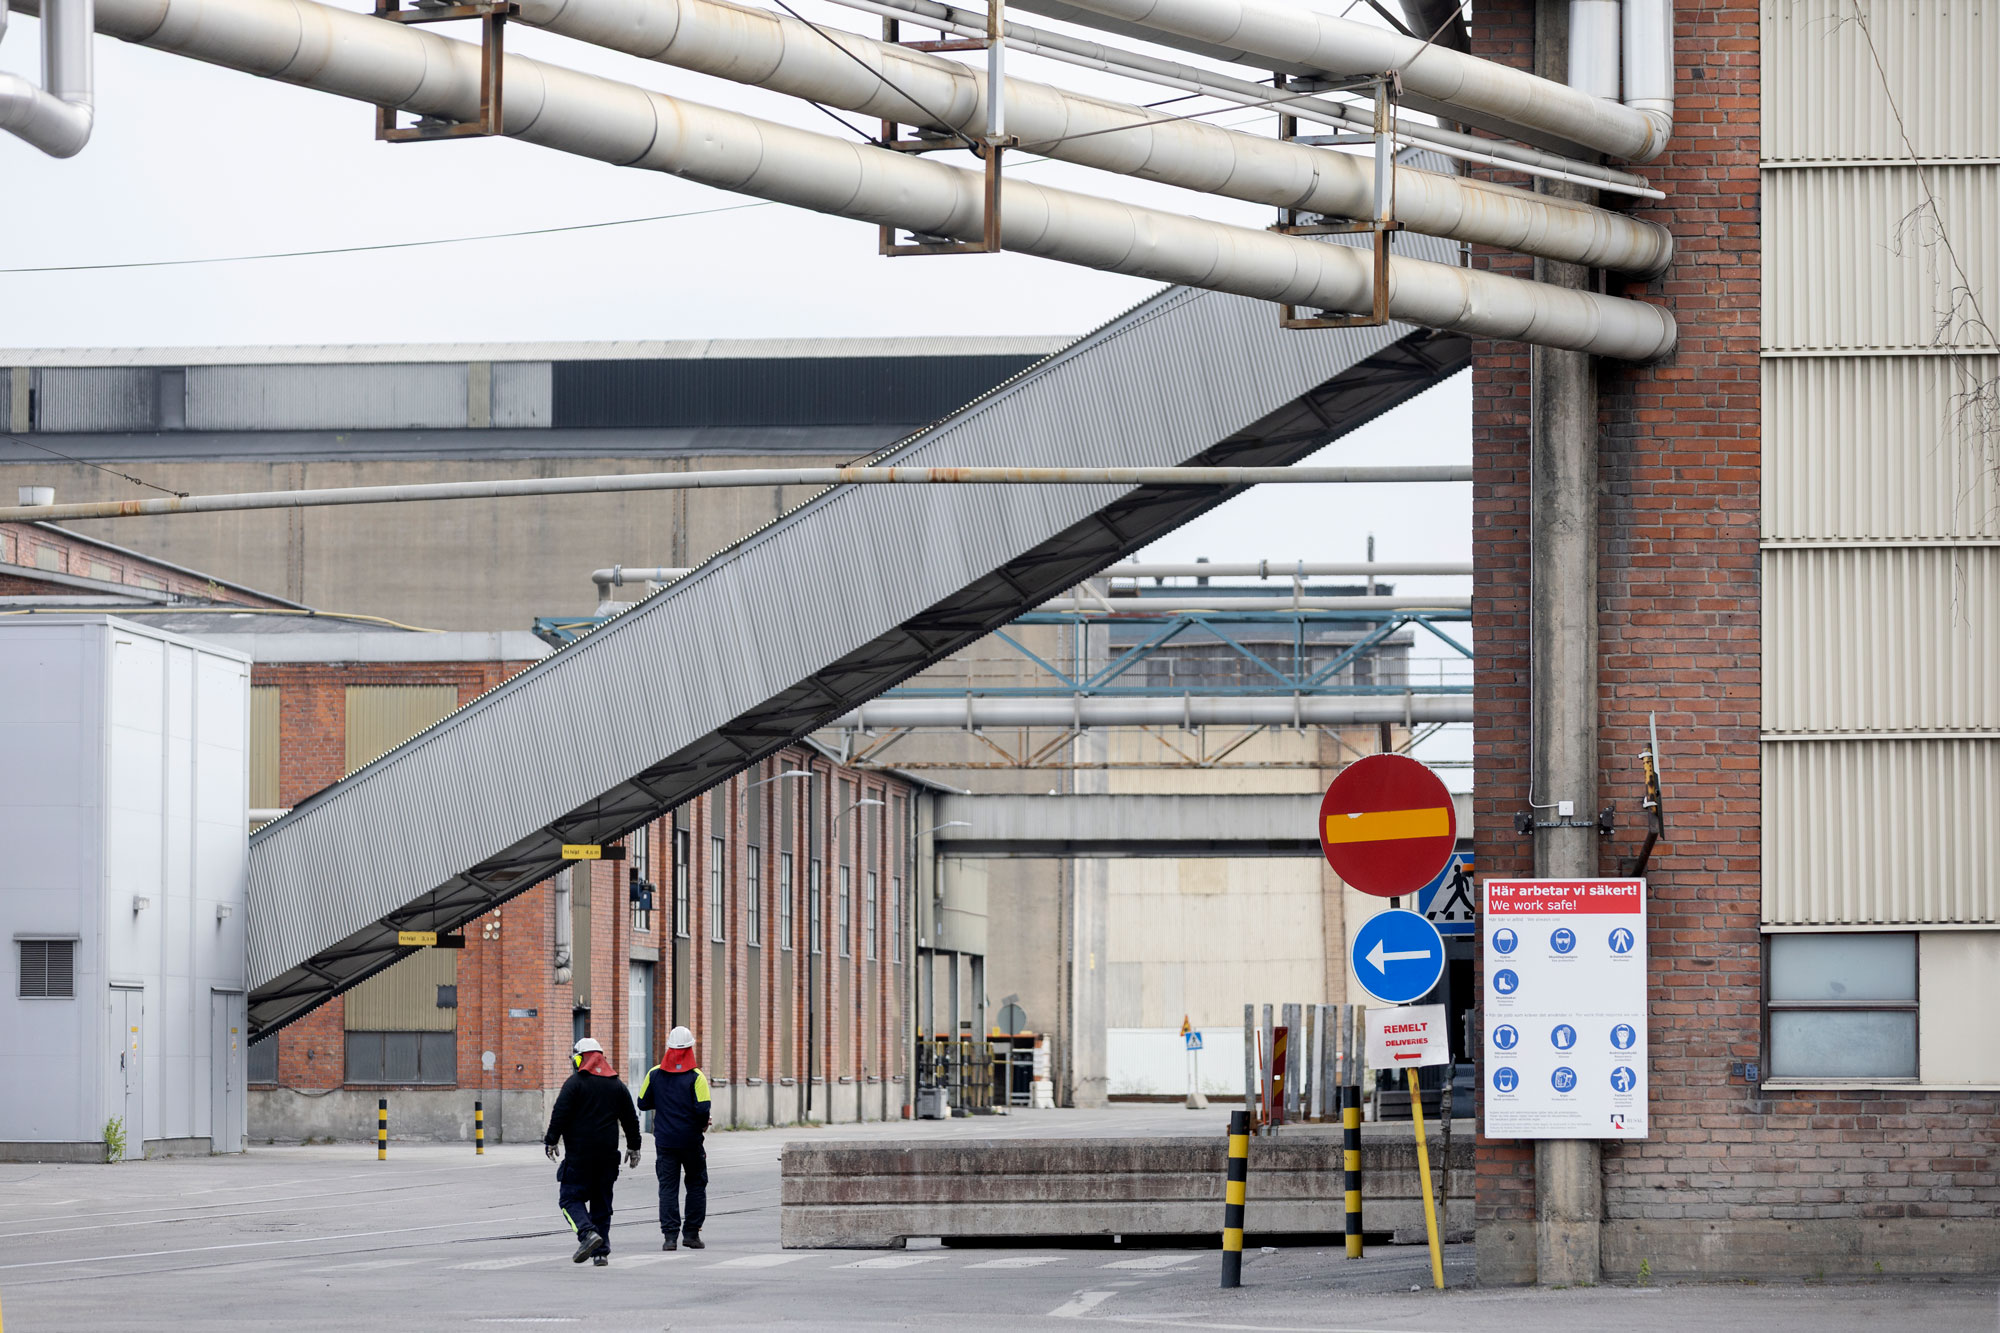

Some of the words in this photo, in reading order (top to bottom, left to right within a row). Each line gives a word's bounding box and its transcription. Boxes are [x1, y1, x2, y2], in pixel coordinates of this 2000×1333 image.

[1491, 885, 1515, 896] Här
[1519, 885, 1570, 896] arbetar
[1573, 885, 1586, 896] vi
[1589, 885, 1637, 896] säkert!
[1491, 900, 1510, 911] We
[1513, 900, 1544, 911] work
[1547, 900, 1577, 910] safe!
[1384, 1022, 1428, 1034] REMELT
[1385, 1037, 1429, 1047] DELIVERIES
